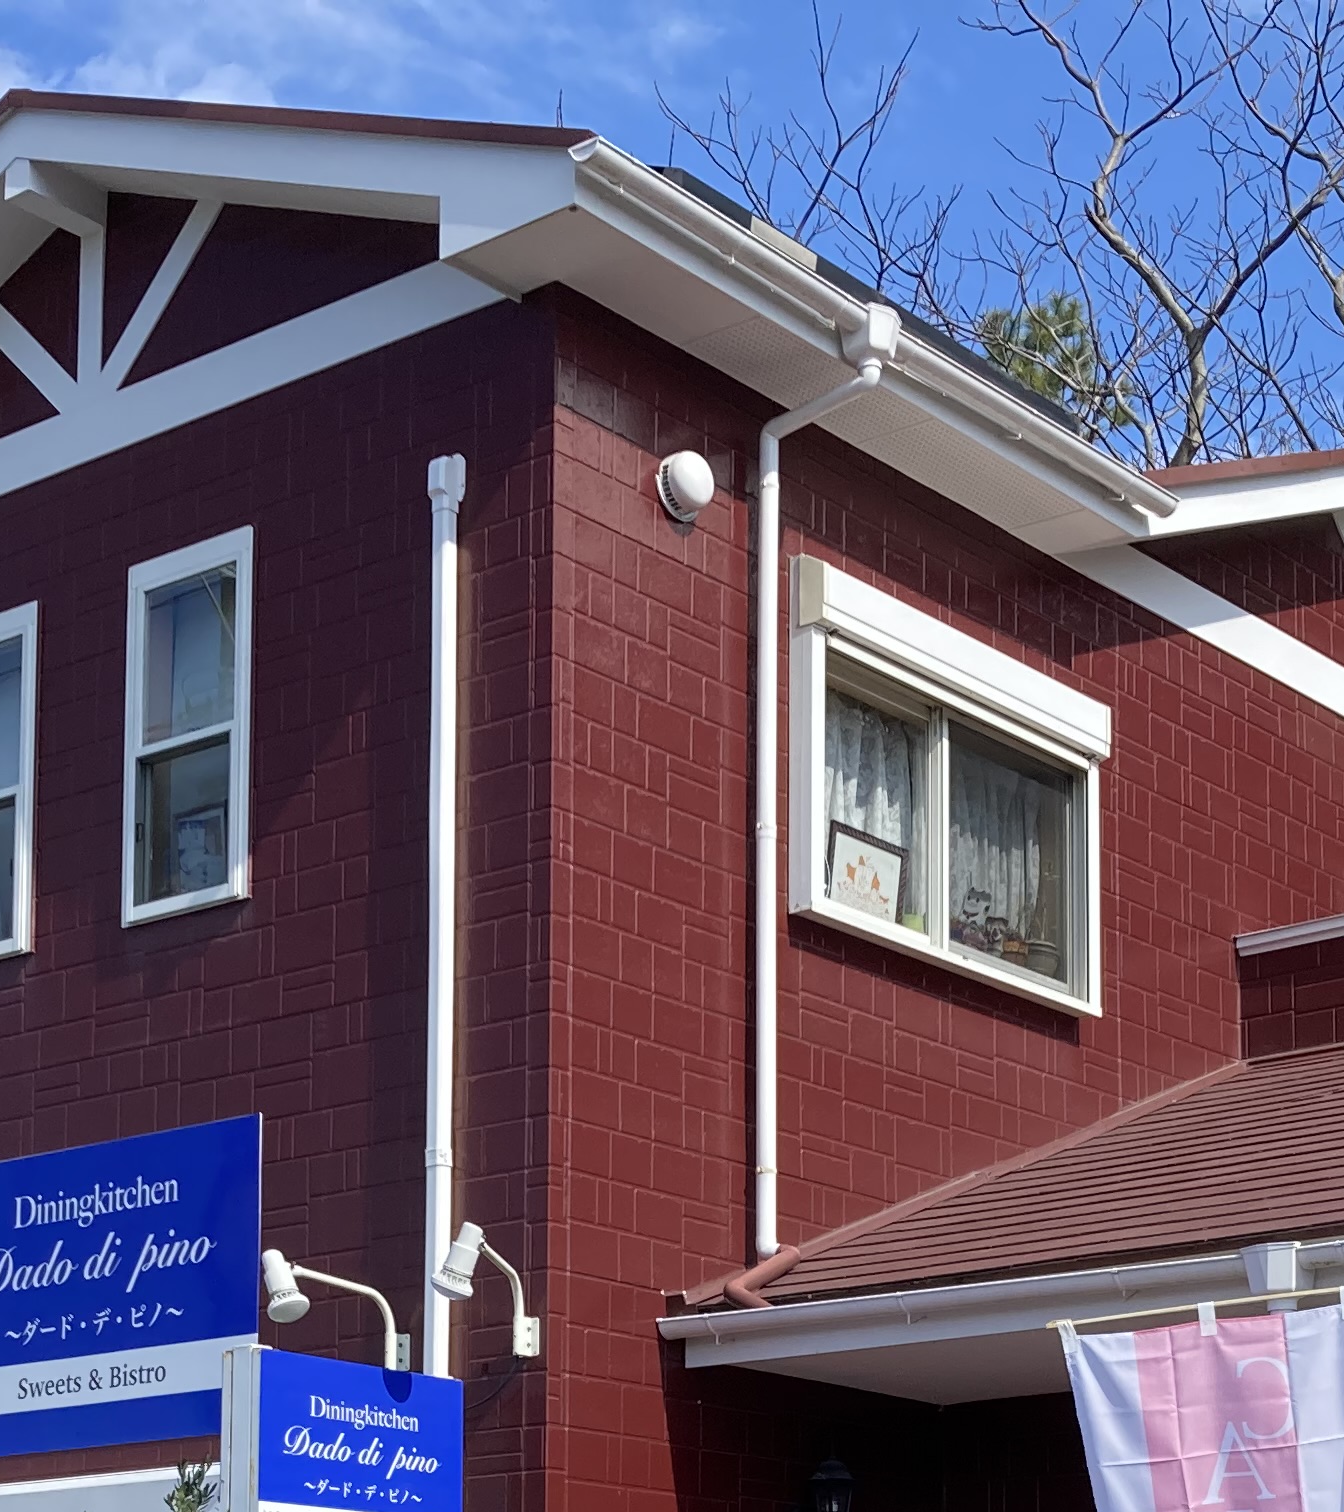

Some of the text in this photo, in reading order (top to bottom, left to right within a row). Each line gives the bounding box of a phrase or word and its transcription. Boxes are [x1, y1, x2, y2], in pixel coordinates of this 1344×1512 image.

[14, 1175, 179, 1229] Diningkitchen
[83, 1231, 122, 1280] di
[126, 1229, 217, 1293] pino
[17, 1363, 167, 1400] Sweets & Bistro
[310, 1395, 419, 1432] Diningkitchen
[283, 1425, 442, 1480] Dado di pino
